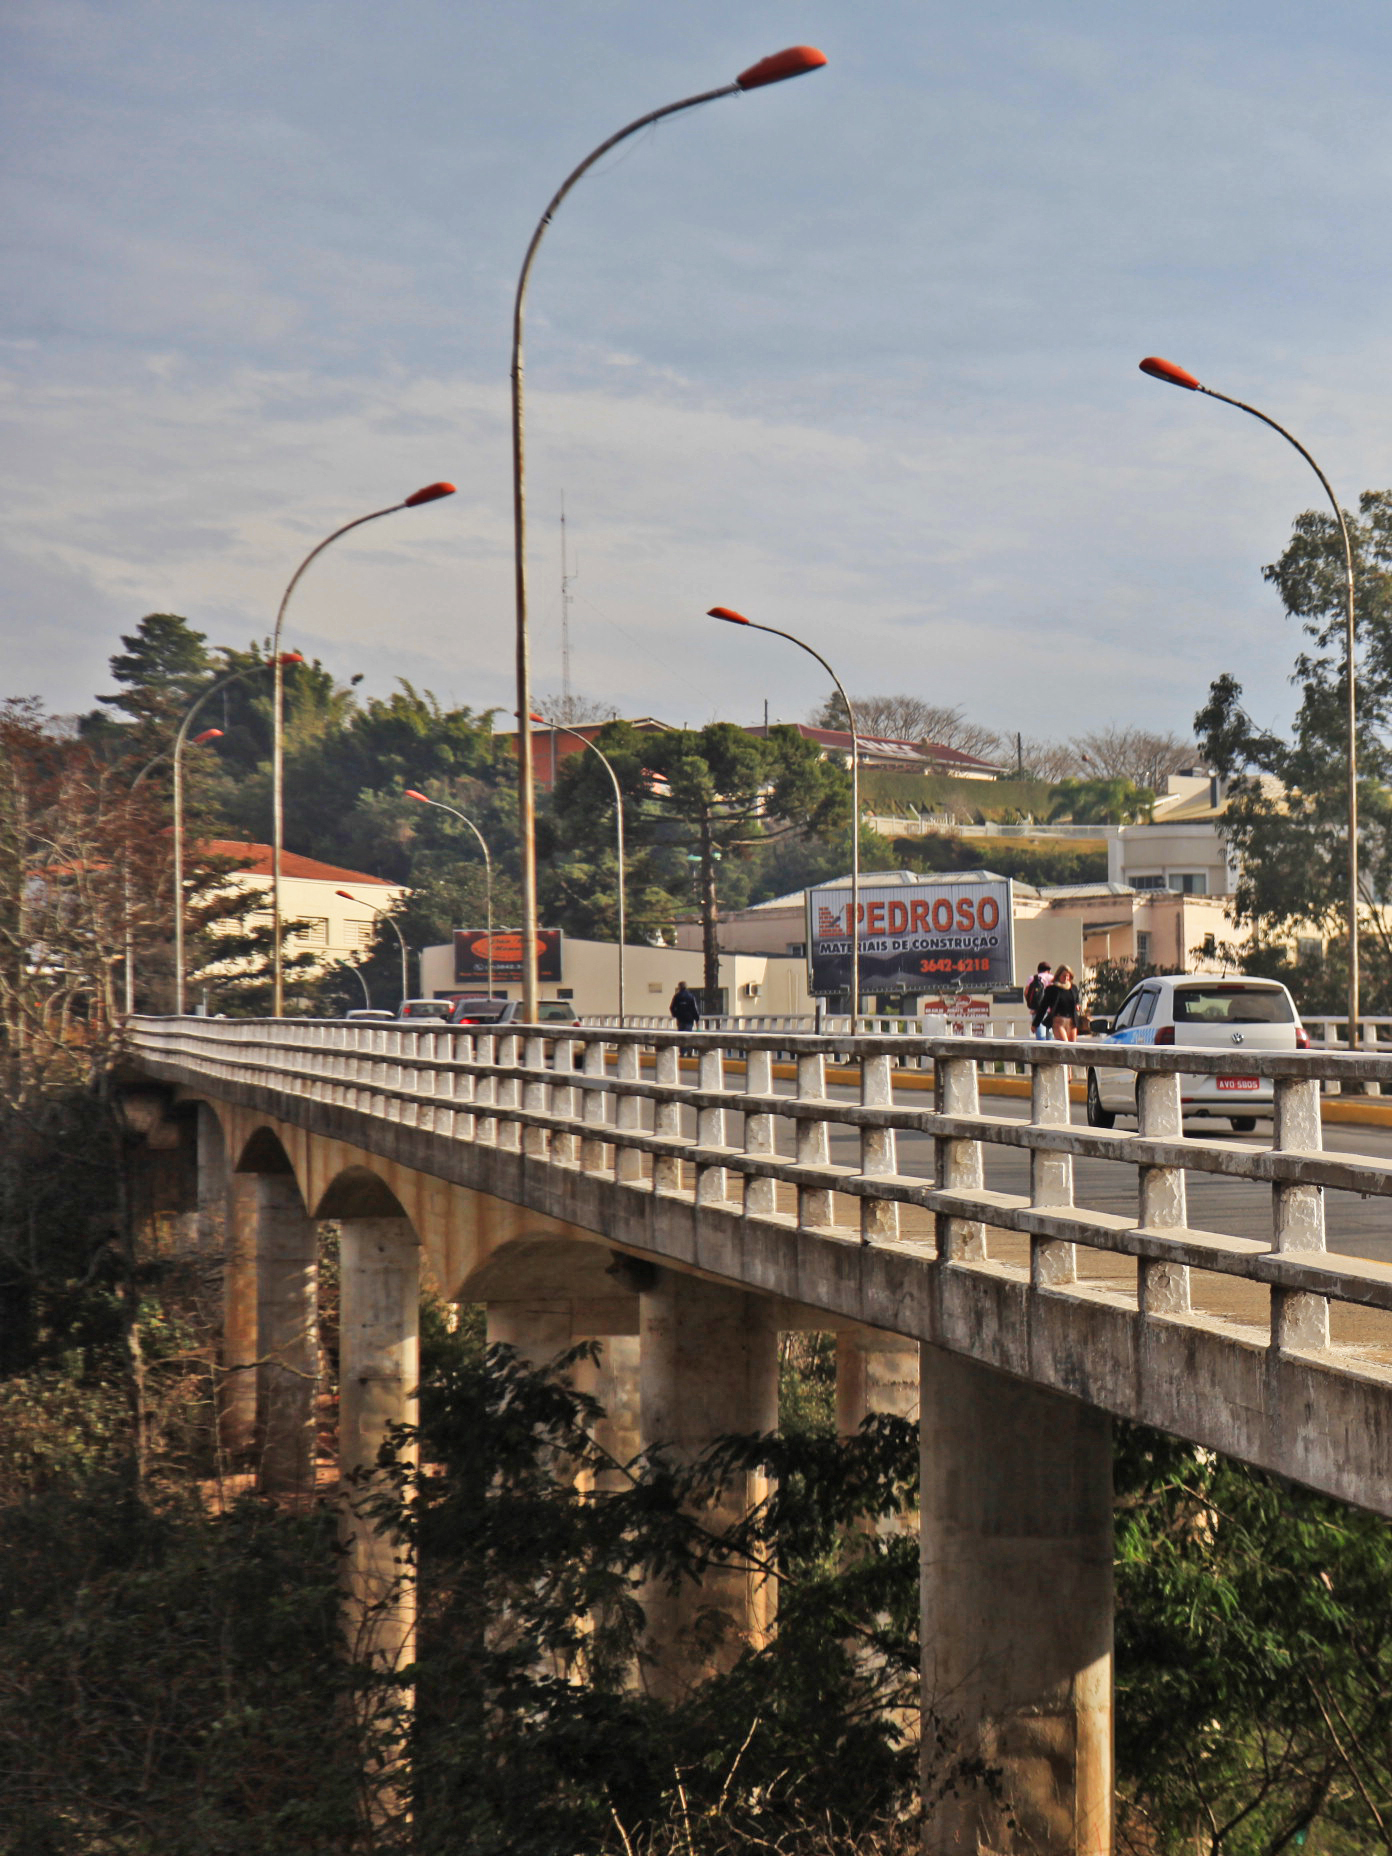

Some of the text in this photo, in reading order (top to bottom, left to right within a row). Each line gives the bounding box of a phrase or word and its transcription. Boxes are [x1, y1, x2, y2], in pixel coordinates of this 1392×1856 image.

[845, 896, 999, 936] PEDROSO
[820, 940, 888, 954] MATERIAIS
[893, 940, 908, 951] DE
[920, 958, 989, 972] 3642-6218
